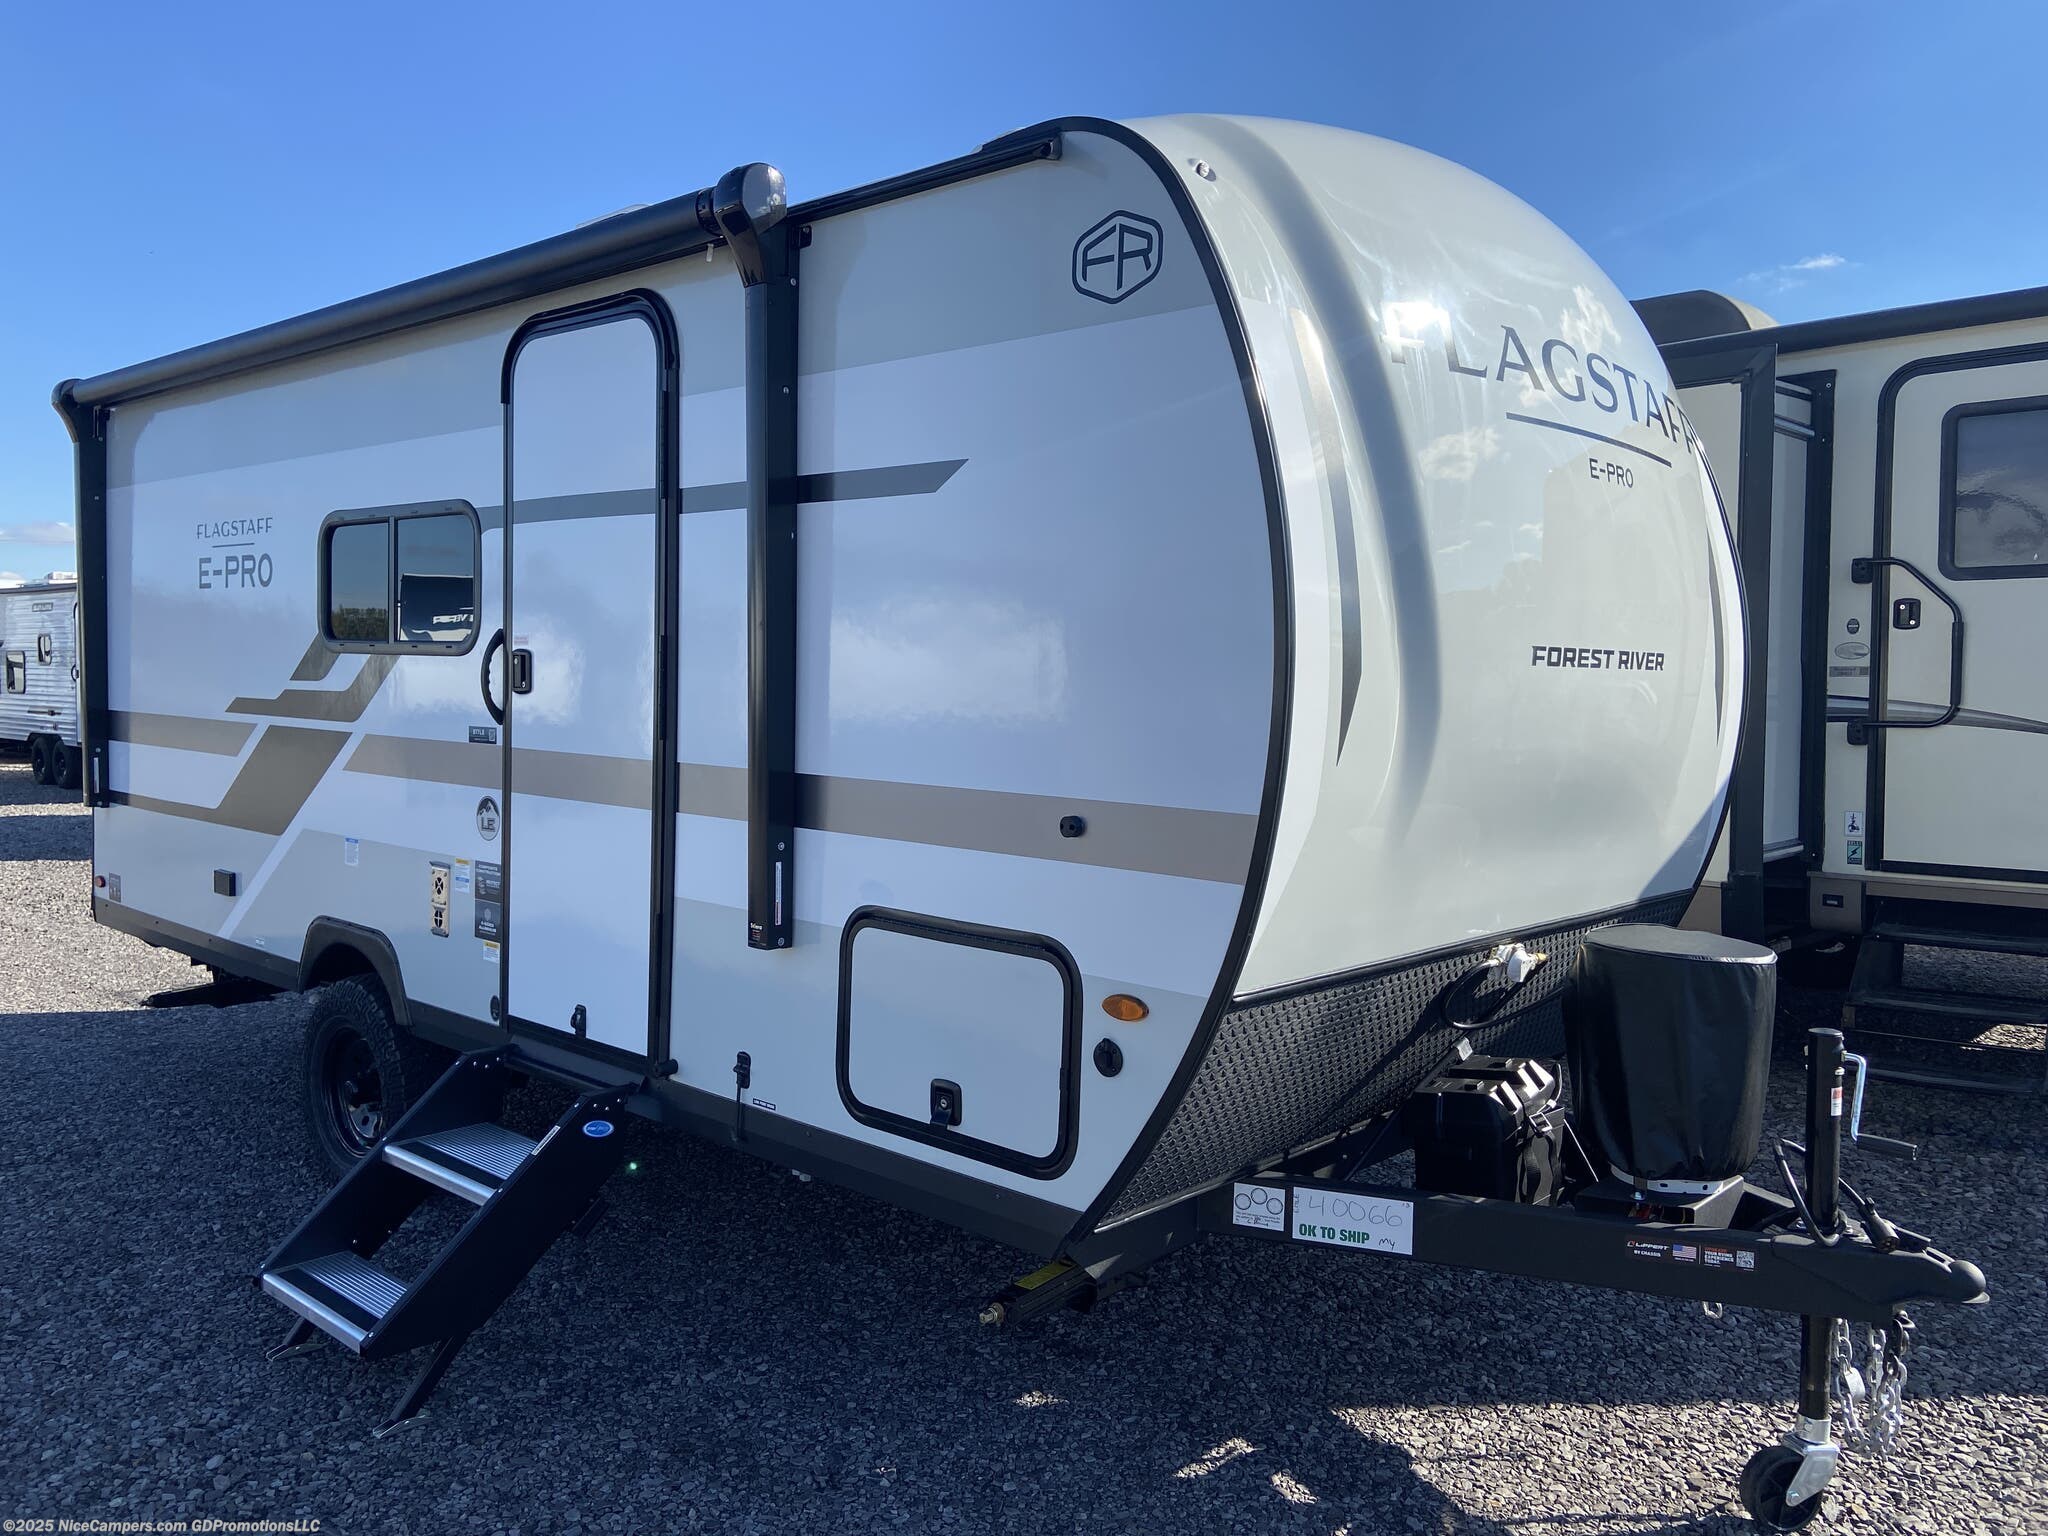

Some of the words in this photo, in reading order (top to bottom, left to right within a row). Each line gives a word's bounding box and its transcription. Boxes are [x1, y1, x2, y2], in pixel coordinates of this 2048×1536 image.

[1588, 457, 1634, 489] E-PRO
[196, 517, 274, 540] FLAGSTAFF
[198, 552, 273, 589] E-PRO
[1531, 645, 1615, 669] FOREST
[1618, 650, 1665, 671] RIVER
[1308, 1195, 1403, 1227] 40066
[1298, 1223, 1318, 1238] OK
[1320, 1226, 1336, 1240] TO
[1339, 1229, 1370, 1244] SHIP
